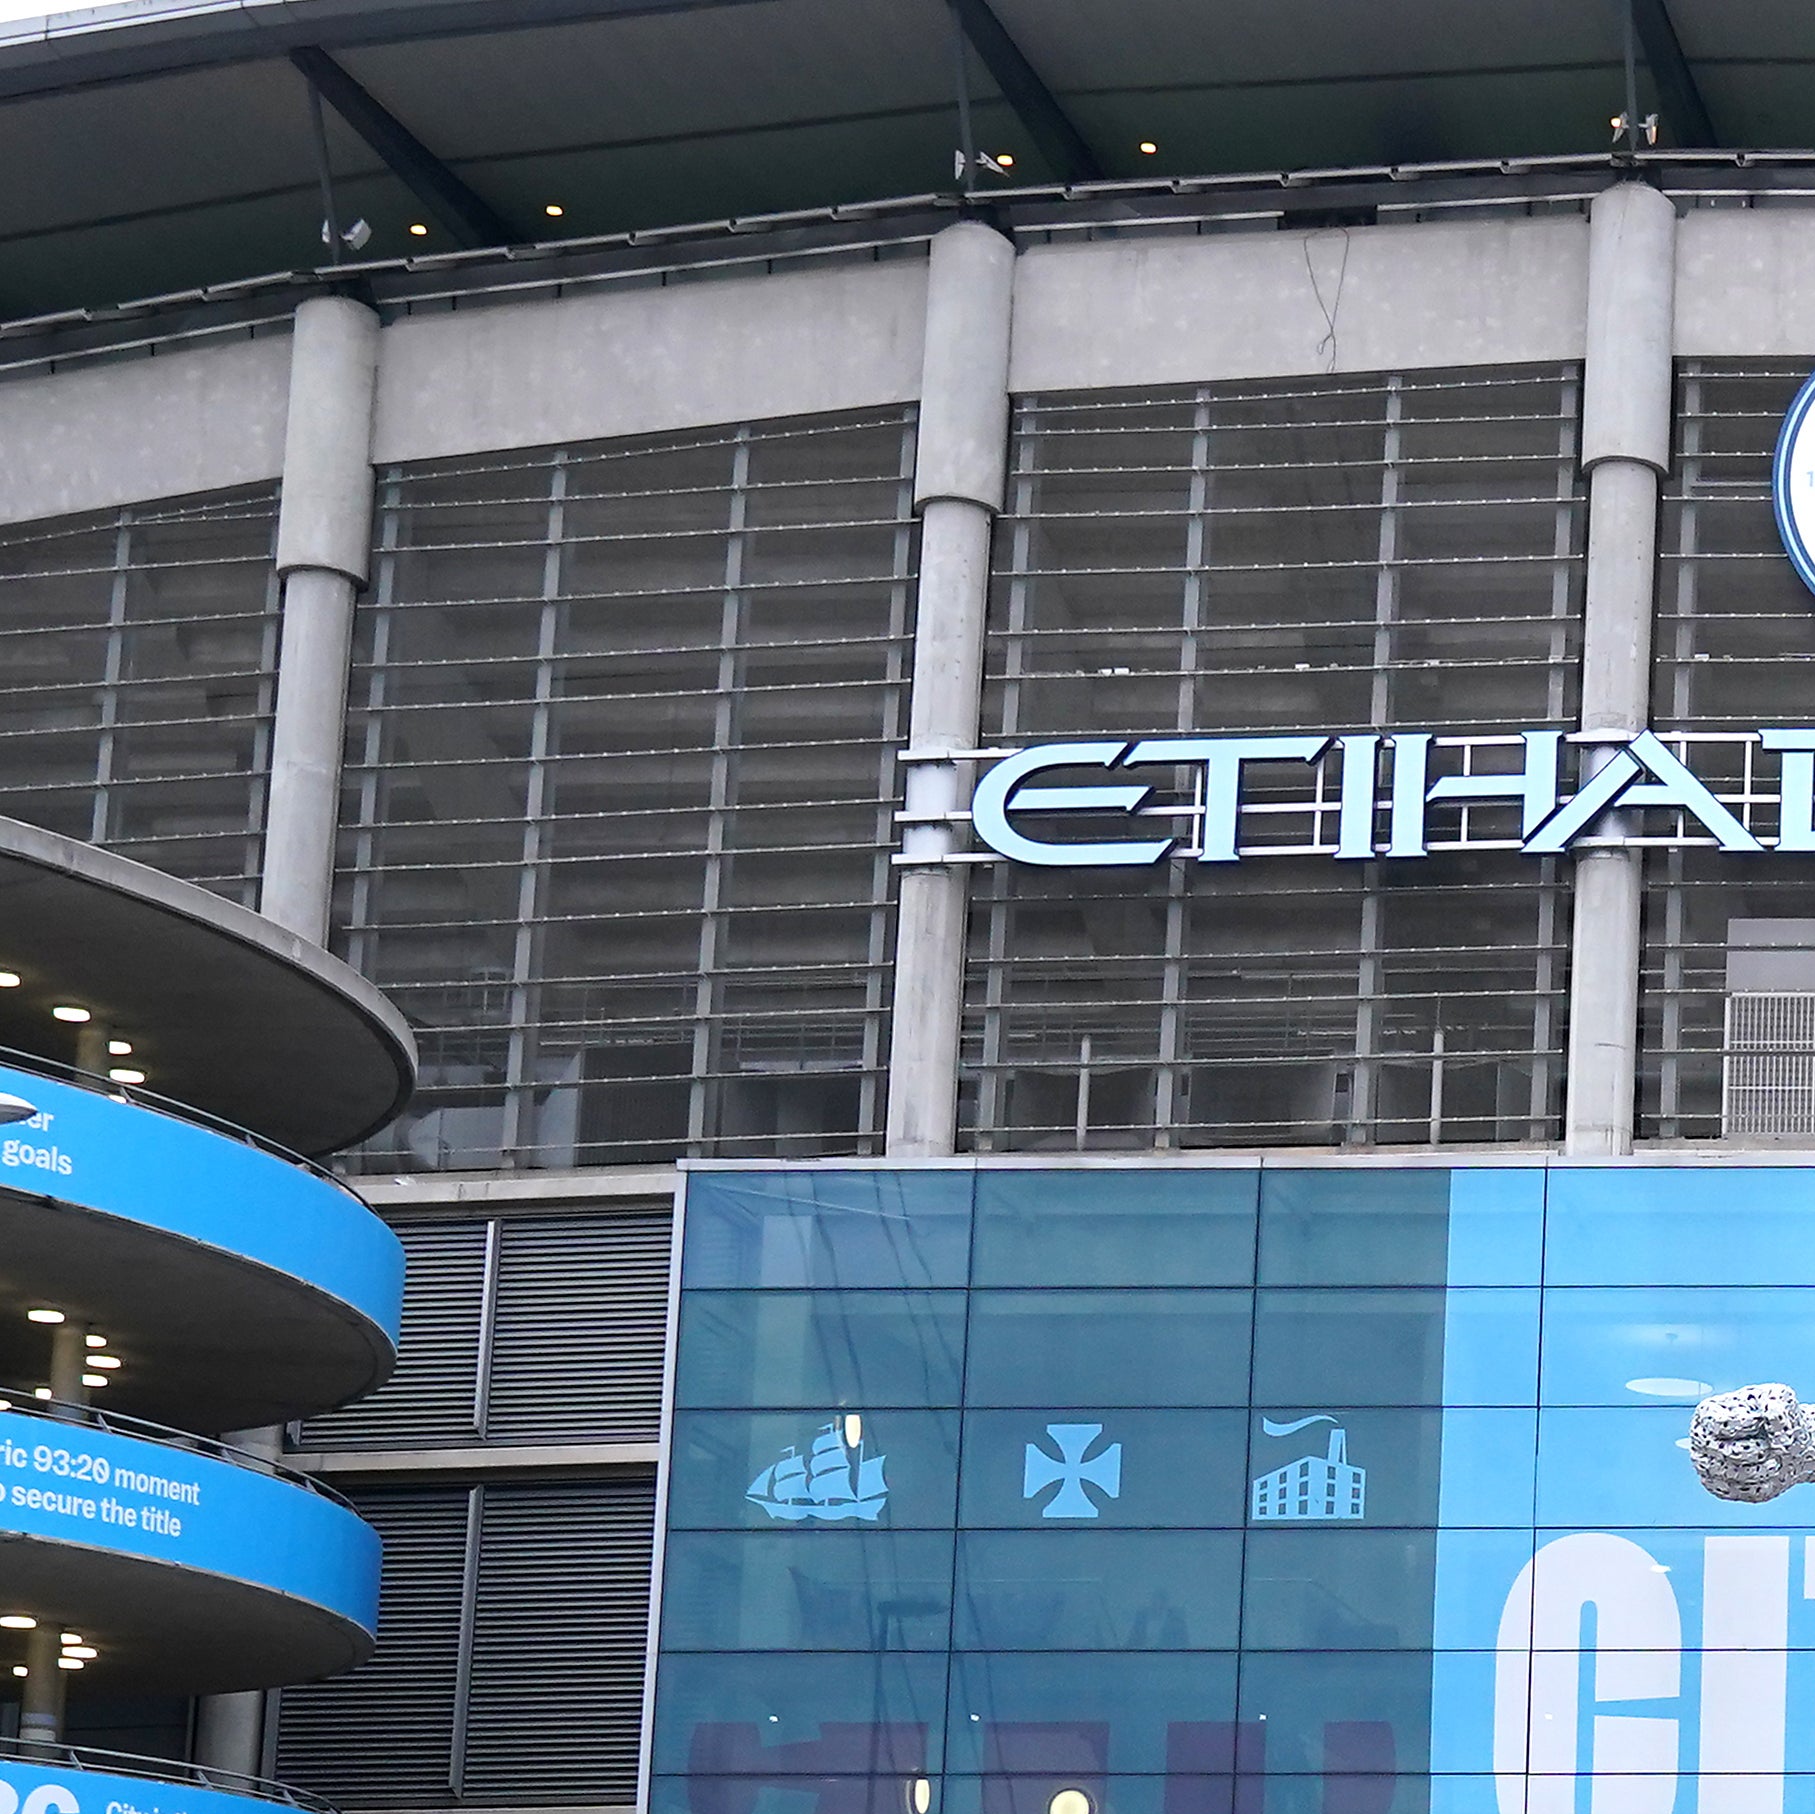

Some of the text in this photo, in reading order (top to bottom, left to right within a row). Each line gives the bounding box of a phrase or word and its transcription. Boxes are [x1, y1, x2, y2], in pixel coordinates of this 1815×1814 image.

[2, 1139, 73, 1175] goals
[34, 1446, 110, 1483] 93:20
[110, 1469, 200, 1510] moment
[12, 1486, 181, 1536] secure the title
